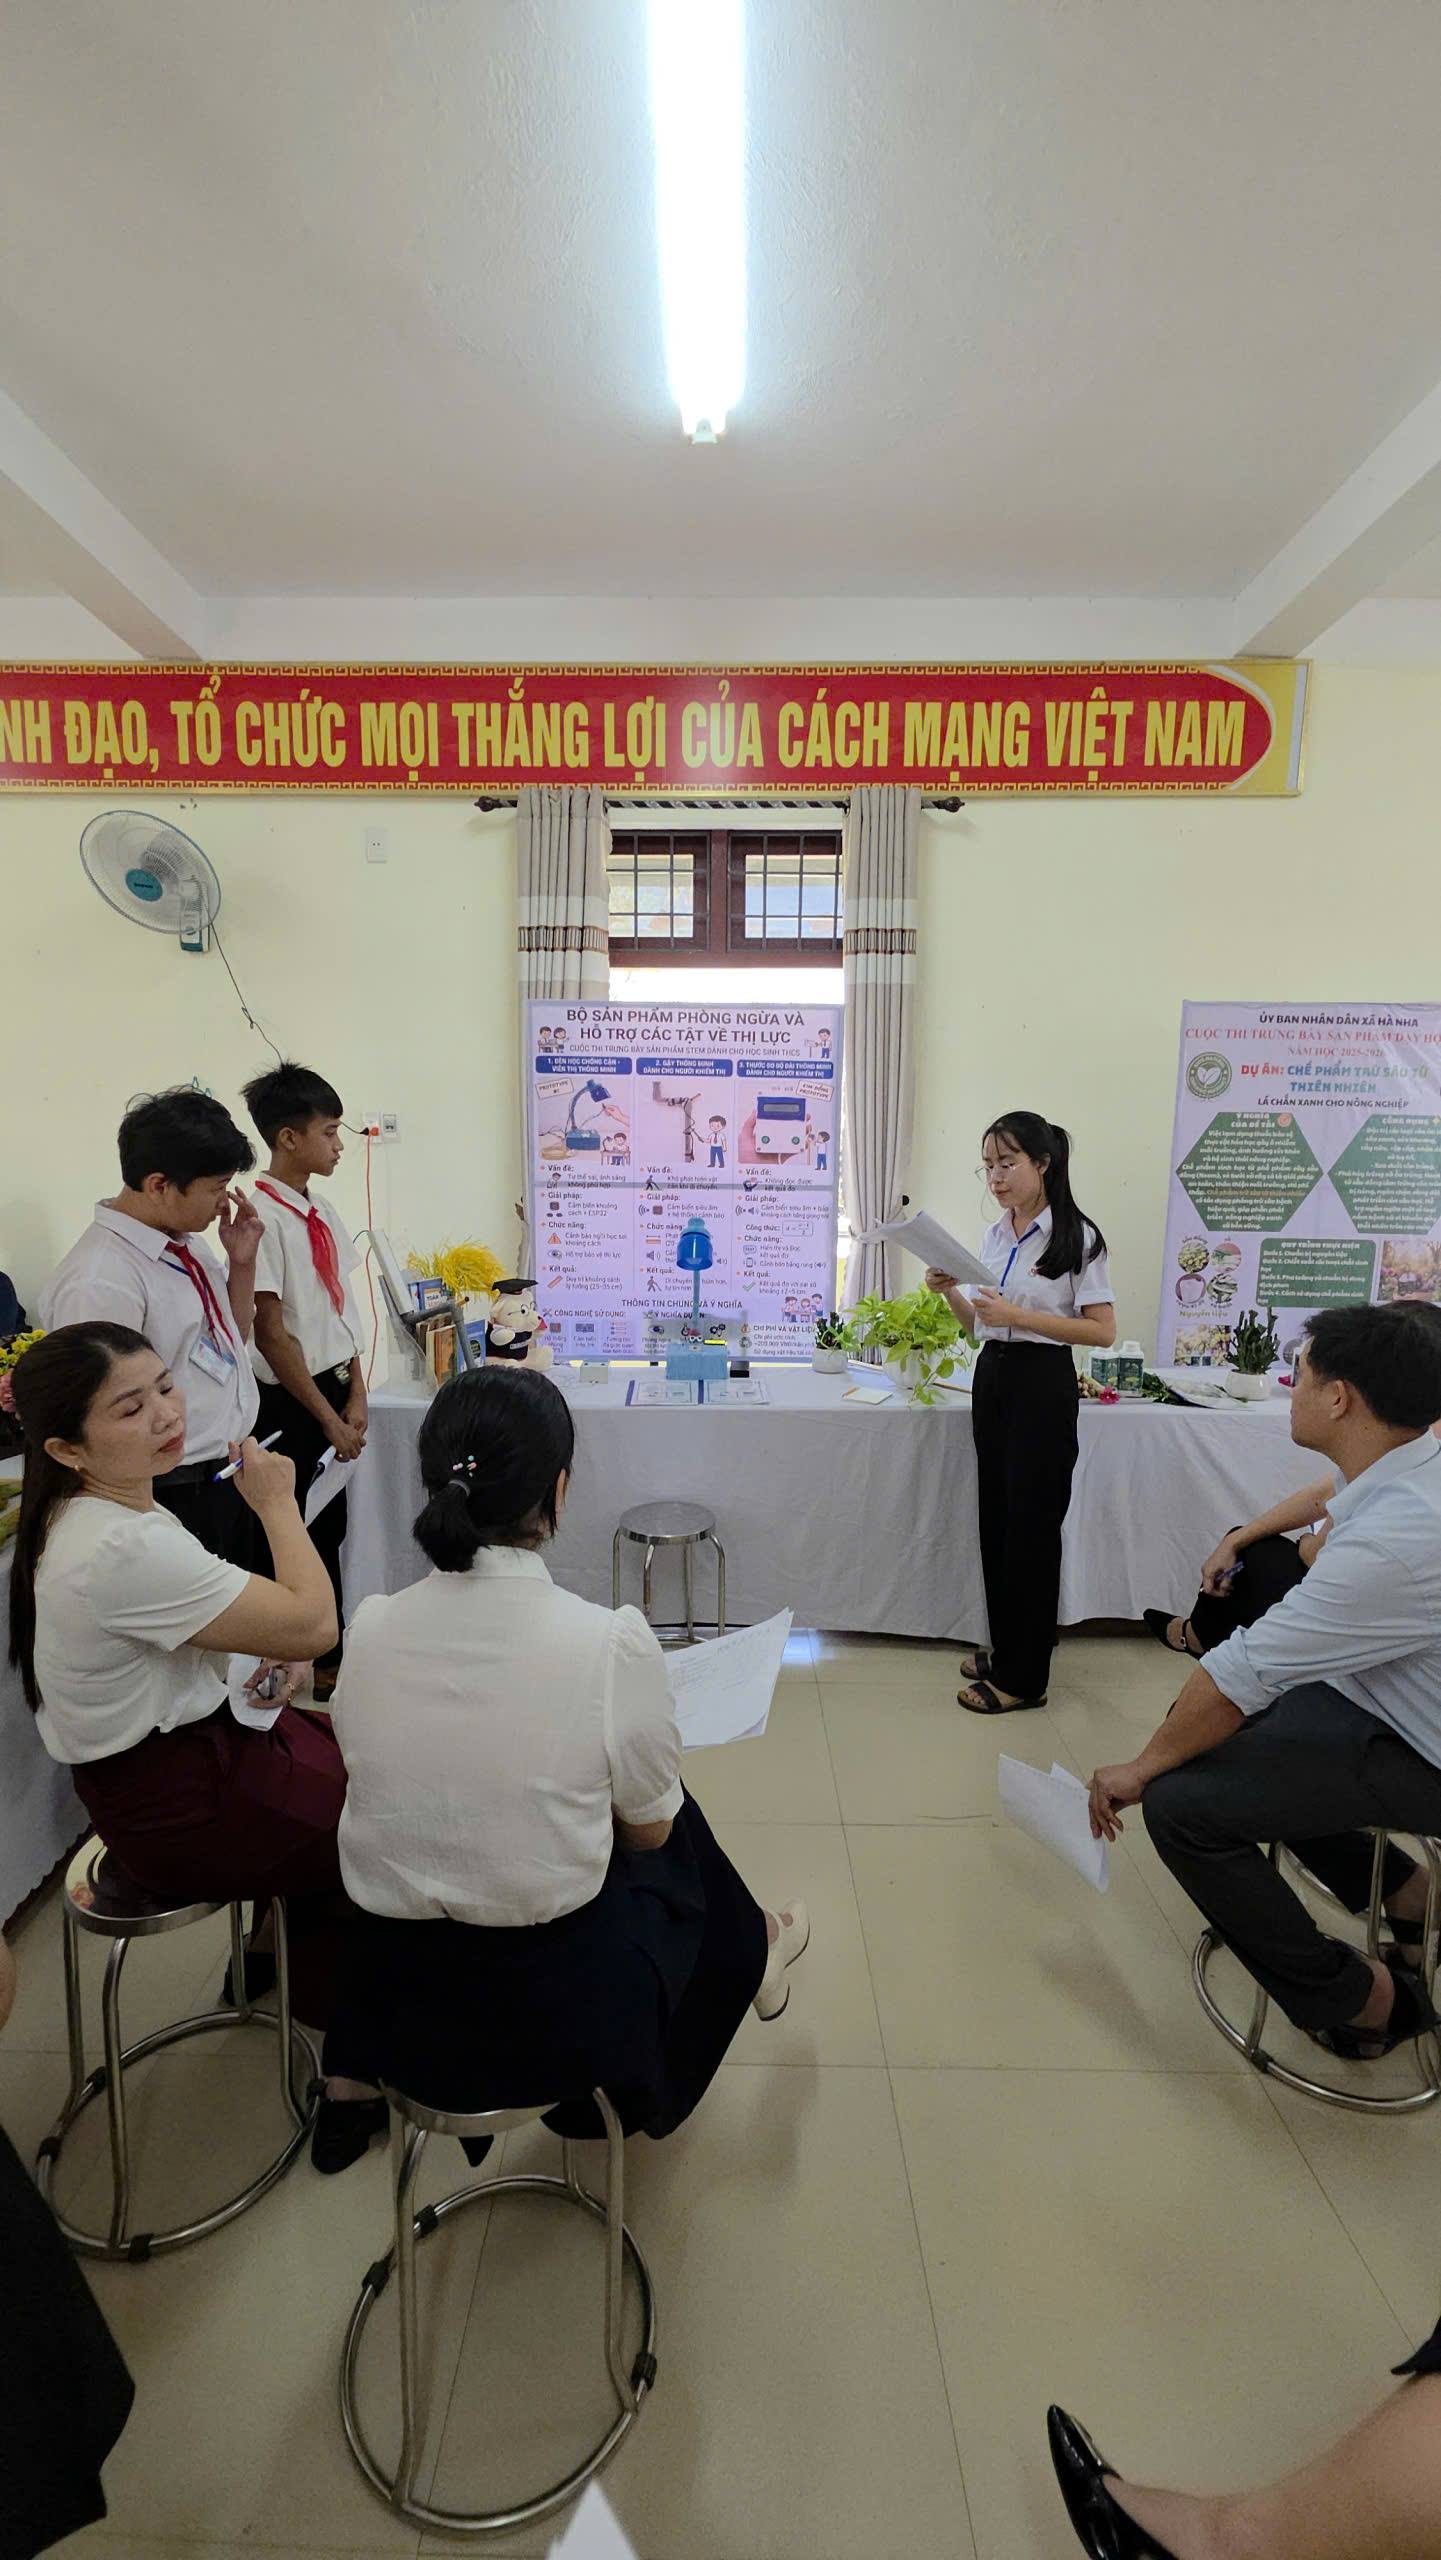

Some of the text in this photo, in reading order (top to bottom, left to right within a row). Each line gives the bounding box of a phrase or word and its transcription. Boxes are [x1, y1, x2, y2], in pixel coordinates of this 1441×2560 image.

[64, 700, 159, 779] ĐẠO,
[170, 674, 222, 766] TỔ
[236, 689, 346, 767] CHỨC
[360, 700, 438, 781] MỌI
[452, 677, 590, 768] THẮNG
[604, 696, 665, 782] LỢI
[681, 679, 765, 768] CỦA
[778, 687, 889, 767] CÁCH
[903, 700, 1029, 782] MẠNG
[1045, 688, 1134, 781] VIỆT
[1145, 700, 1246, 766] NAM
[567, 1006, 804, 1026] BỘ SẢN PHẨM PHÒNG NGỪA VÀ
[1259, 1011, 1418, 1027] ỦY BAN NHÂN DÂN XÃ HÀ NHA
[580, 1024, 791, 1046] HỖ TRỢ CÁC TẬT VỀ THỊ LỰC
[1226, 1029, 1247, 1039] THI
[686, 1047, 706, 1056] STEM
[729, 1048, 744, 1057] CHO
[746, 1048, 761, 1058] HỌC
[763, 1048, 780, 1057] SINH
[781, 1049, 800, 1059] THCS
[1241, 1064, 1260, 1077] DỰ
[1287, 1060, 1312, 1076] CHẾ
[1315, 1060, 1352, 1076] PHẨM
[1290, 1079, 1376, 1093] THIÊN NHIÊN
[1258, 1093, 1409, 1110] LÁ CHẮN XANH CHO NÔNG NGHIỆP
[548, 1221, 566, 1229] Chức
[744, 1234, 761, 1242] Chức
[549, 1265, 577, 1274] Kết quả:
[647, 1266, 659, 1274] Kết
[744, 1270, 756, 1278] Kết
[621, 1298, 649, 1307] THÔNG
[652, 1299, 665, 1307] TIN
[717, 1299, 742, 1309] NGHĨA
[554, 1309, 572, 1317] CÔNG
[574, 1309, 593, 1318] NGHỆ
[594, 1309, 604, 1317] SỬ
[660, 1310, 682, 1318] NGHĨA
[753, 1324, 763, 1332] CHI
[765, 1324, 777, 1332] PHÍ
[778, 1325, 787, 1333] VÀ
[788, 1325, 800, 1333] VẬT
